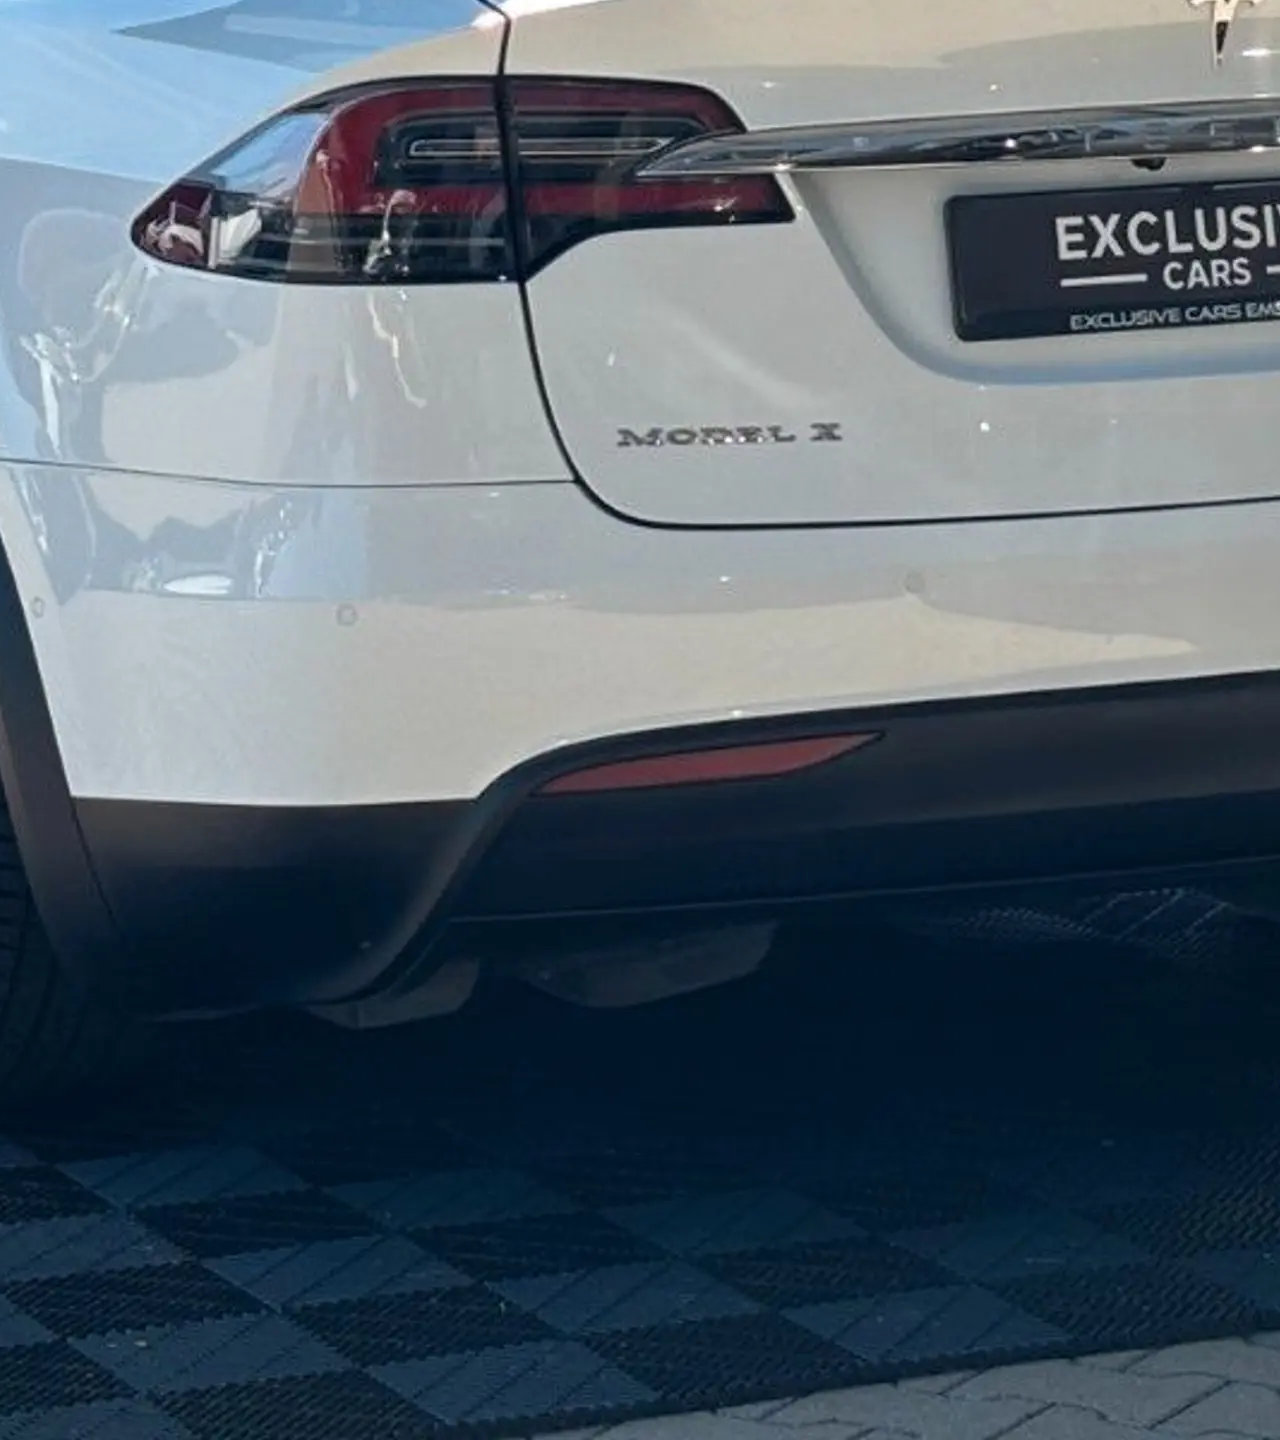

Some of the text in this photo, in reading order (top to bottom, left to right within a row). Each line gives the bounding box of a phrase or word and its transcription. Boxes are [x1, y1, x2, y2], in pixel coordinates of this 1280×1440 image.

[1162, 257, 1253, 290] CARS
[1070, 307, 1182, 331] EXCLUSIVE
[1184, 303, 1242, 322] CARS
[617, 421, 843, 447] MODEL X
